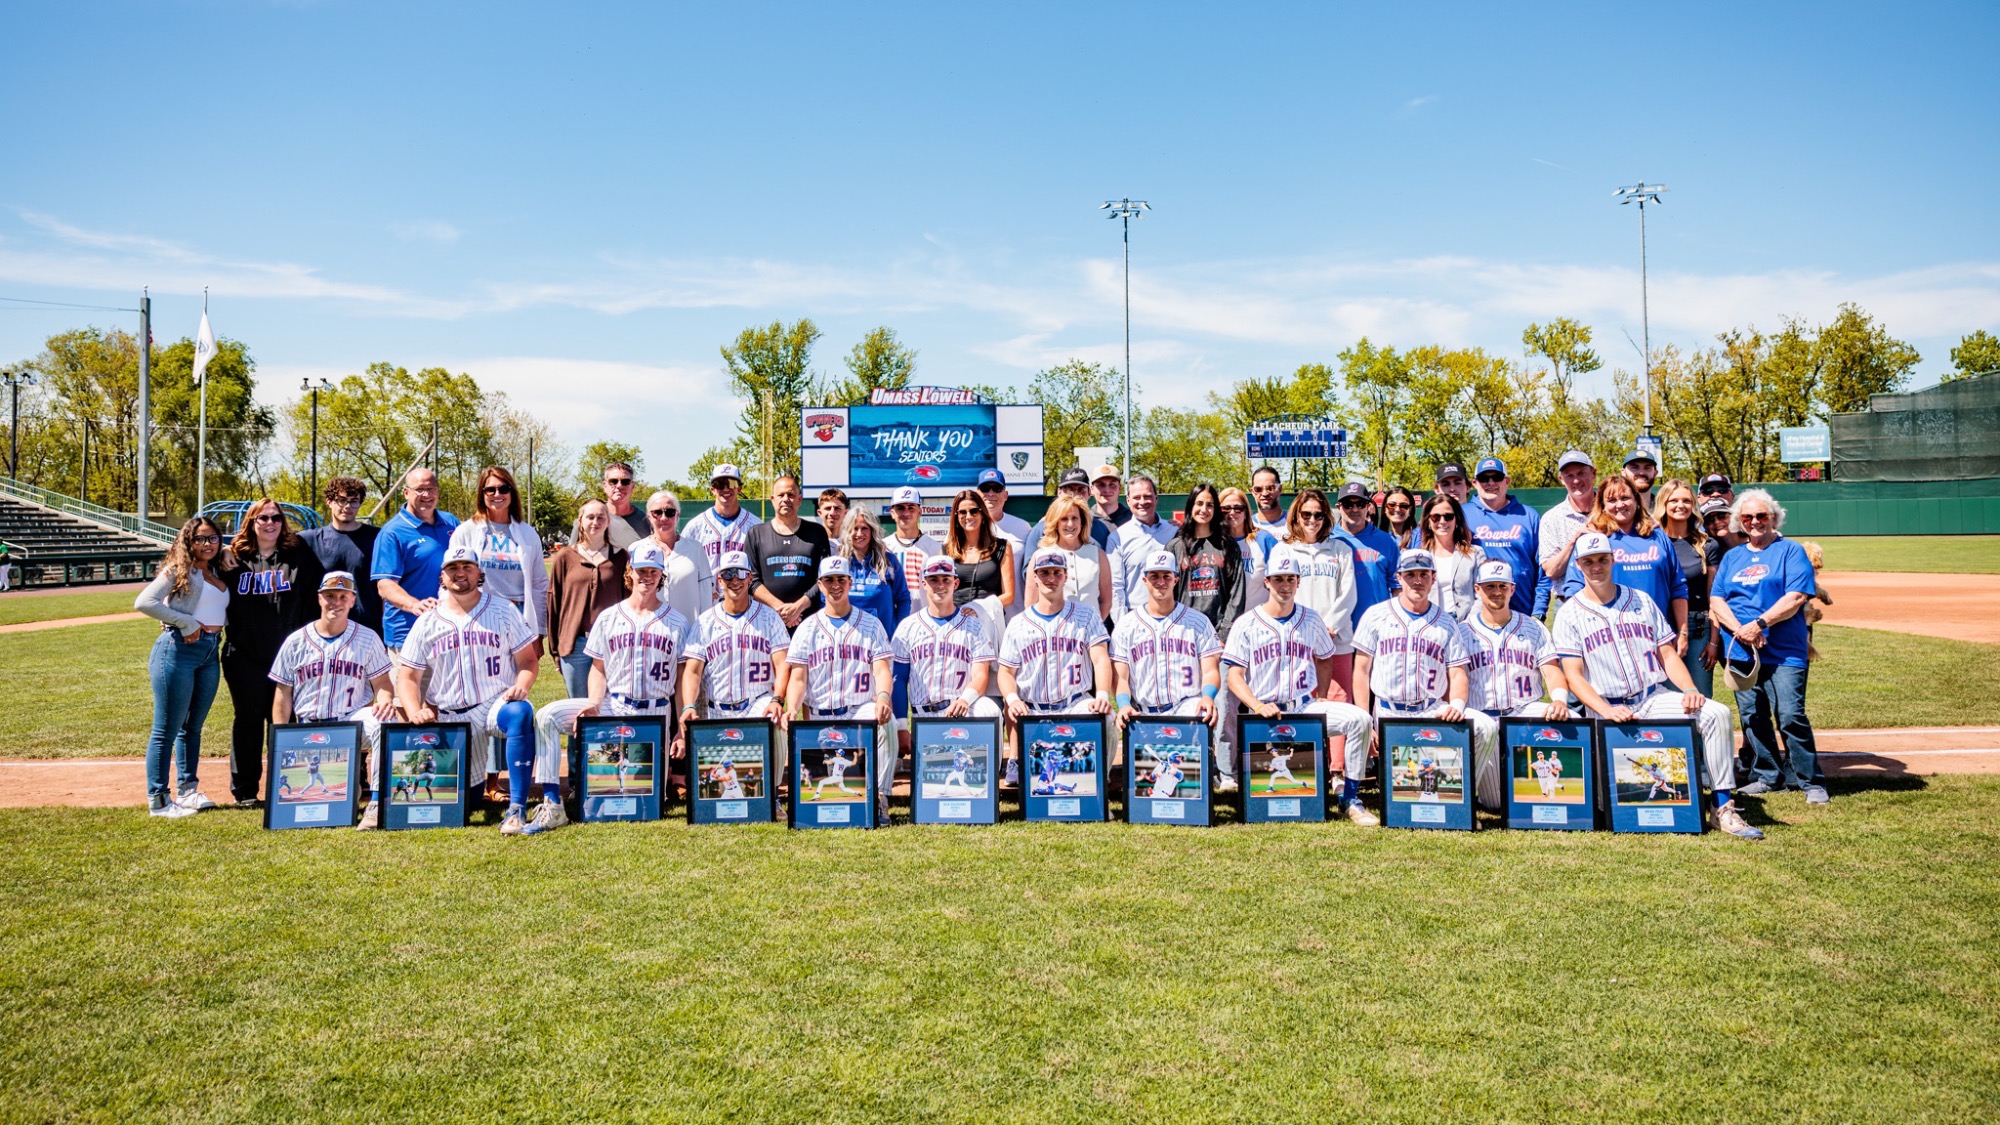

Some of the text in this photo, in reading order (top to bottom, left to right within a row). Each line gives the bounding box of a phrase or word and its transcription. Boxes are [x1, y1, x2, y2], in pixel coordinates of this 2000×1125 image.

[872, 387, 974, 404] UMASS LOWELL
[871, 425, 973, 458] THANK YOU
[898, 450, 947, 463] SENIORS
[922, 506, 945, 514] TODAY
[1473, 524, 1522, 540] Lowell
[453, 549, 465, 559] L
[1588, 538, 1600, 549] L
[1612, 545, 1660, 563] Lowell
[644, 550, 656, 560] L
[728, 553, 739, 563] L
[829, 559, 841, 569] L
[1154, 555, 1167, 565] L
[1278, 559, 1290, 570] L
[1491, 565, 1503, 575] L
[238, 570, 291, 594] UML
[432, 630, 500, 658] RIVER HAWKS
[608, 631, 673, 656] RIVER HAWKS
[706, 633, 771, 661] RIVER HAWKS
[1130, 636, 1196, 663] RIVER HAWKS
[1584, 623, 1654, 654] RIVER HAWKS
[808, 643, 872, 669] RIVER HAWKS
[910, 641, 972, 664] RIVER HAWKS
[1021, 636, 1085, 665] RIVER HAWKS
[1253, 640, 1312, 666] RIVER HAWK
[1380, 636, 1445, 664] RIVER HAWKS
[1499, 648, 1535, 670] HAWKS
[297, 658, 364, 685] RIVER HAWKS
[485, 655, 501, 677] 16
[650, 661, 670, 682] 45
[749, 662, 771, 682] 23
[1067, 664, 1082, 686] 13
[1182, 666, 1193, 687] 3
[853, 671, 871, 694] 19
[955, 671, 966, 690] 7
[1296, 670, 1309, 690] 12
[1427, 669, 1437, 691] 2
[1515, 675, 1532, 698] 14
